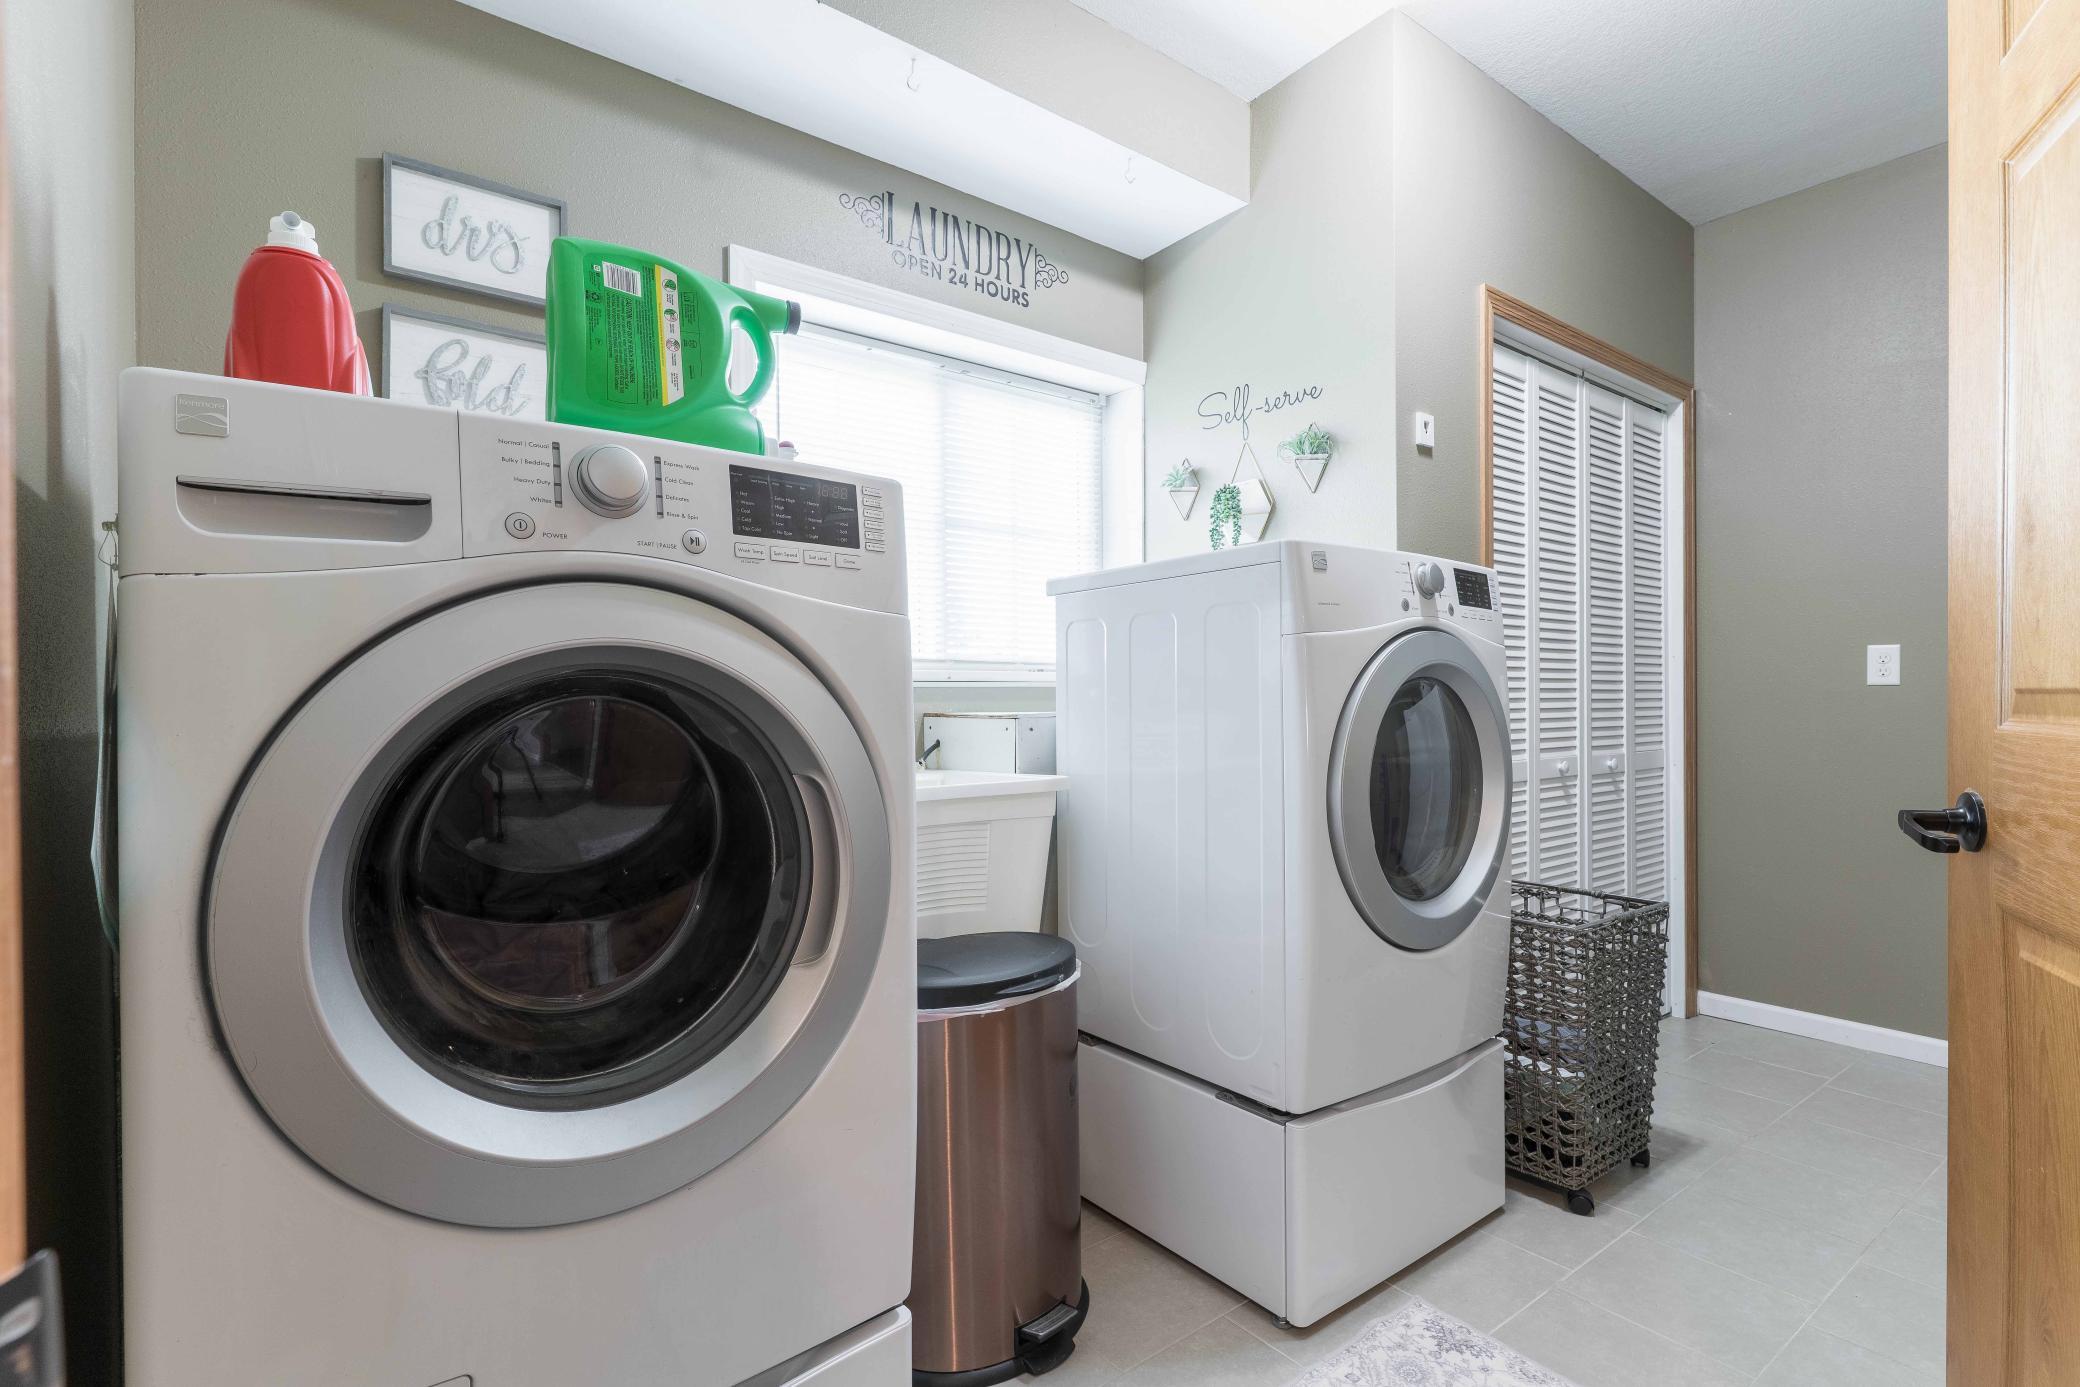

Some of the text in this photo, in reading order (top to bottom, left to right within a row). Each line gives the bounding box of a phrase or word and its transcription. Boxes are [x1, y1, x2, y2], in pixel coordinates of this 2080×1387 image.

[886, 191, 1034, 289] LAUNDRY
[891, 250, 1030, 308] OPEN 24 HOURS
[1198, 383, 1323, 441] Self-serve
[498, 438, 523, 446] Normal
[528, 441, 550, 449] Casual
[501, 456, 519, 464] Bulky
[524, 458, 550, 467] Bedding
[513, 476, 535, 484] Heavy
[529, 496, 552, 504] Whites
[542, 531, 568, 540] POWER
[659, 542, 678, 550] PAUSE
